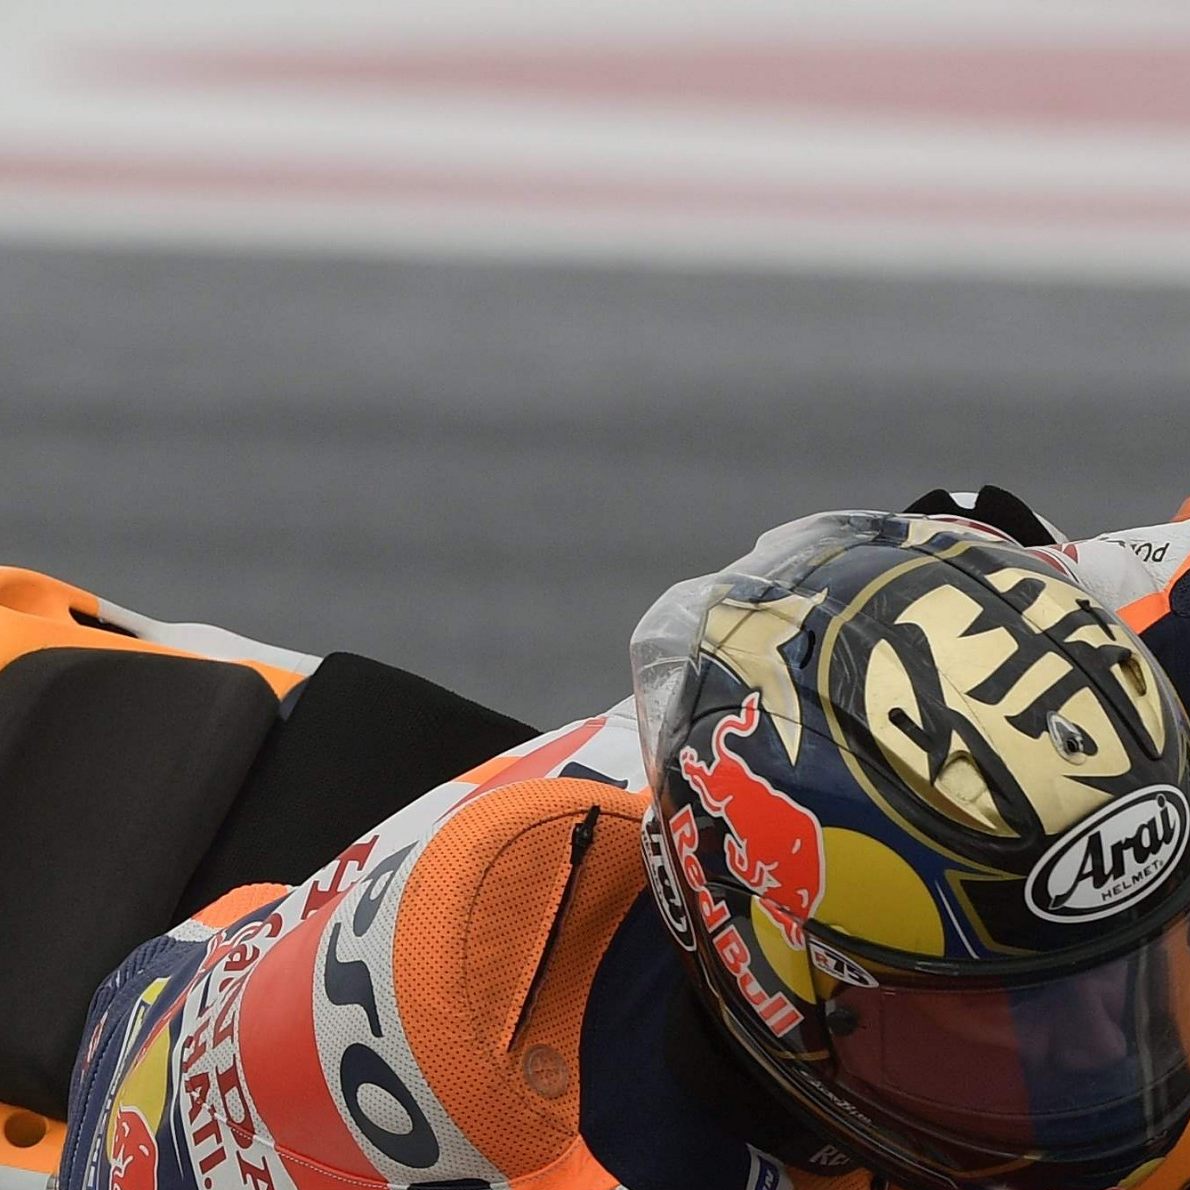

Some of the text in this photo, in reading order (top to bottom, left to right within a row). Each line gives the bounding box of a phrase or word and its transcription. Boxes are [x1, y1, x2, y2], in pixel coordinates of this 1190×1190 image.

[1048, 793, 1177, 909] Arai
[1101, 860, 1161, 901] HELMET
[669, 804, 732, 934] Red
[712, 924, 805, 1039] Bull
